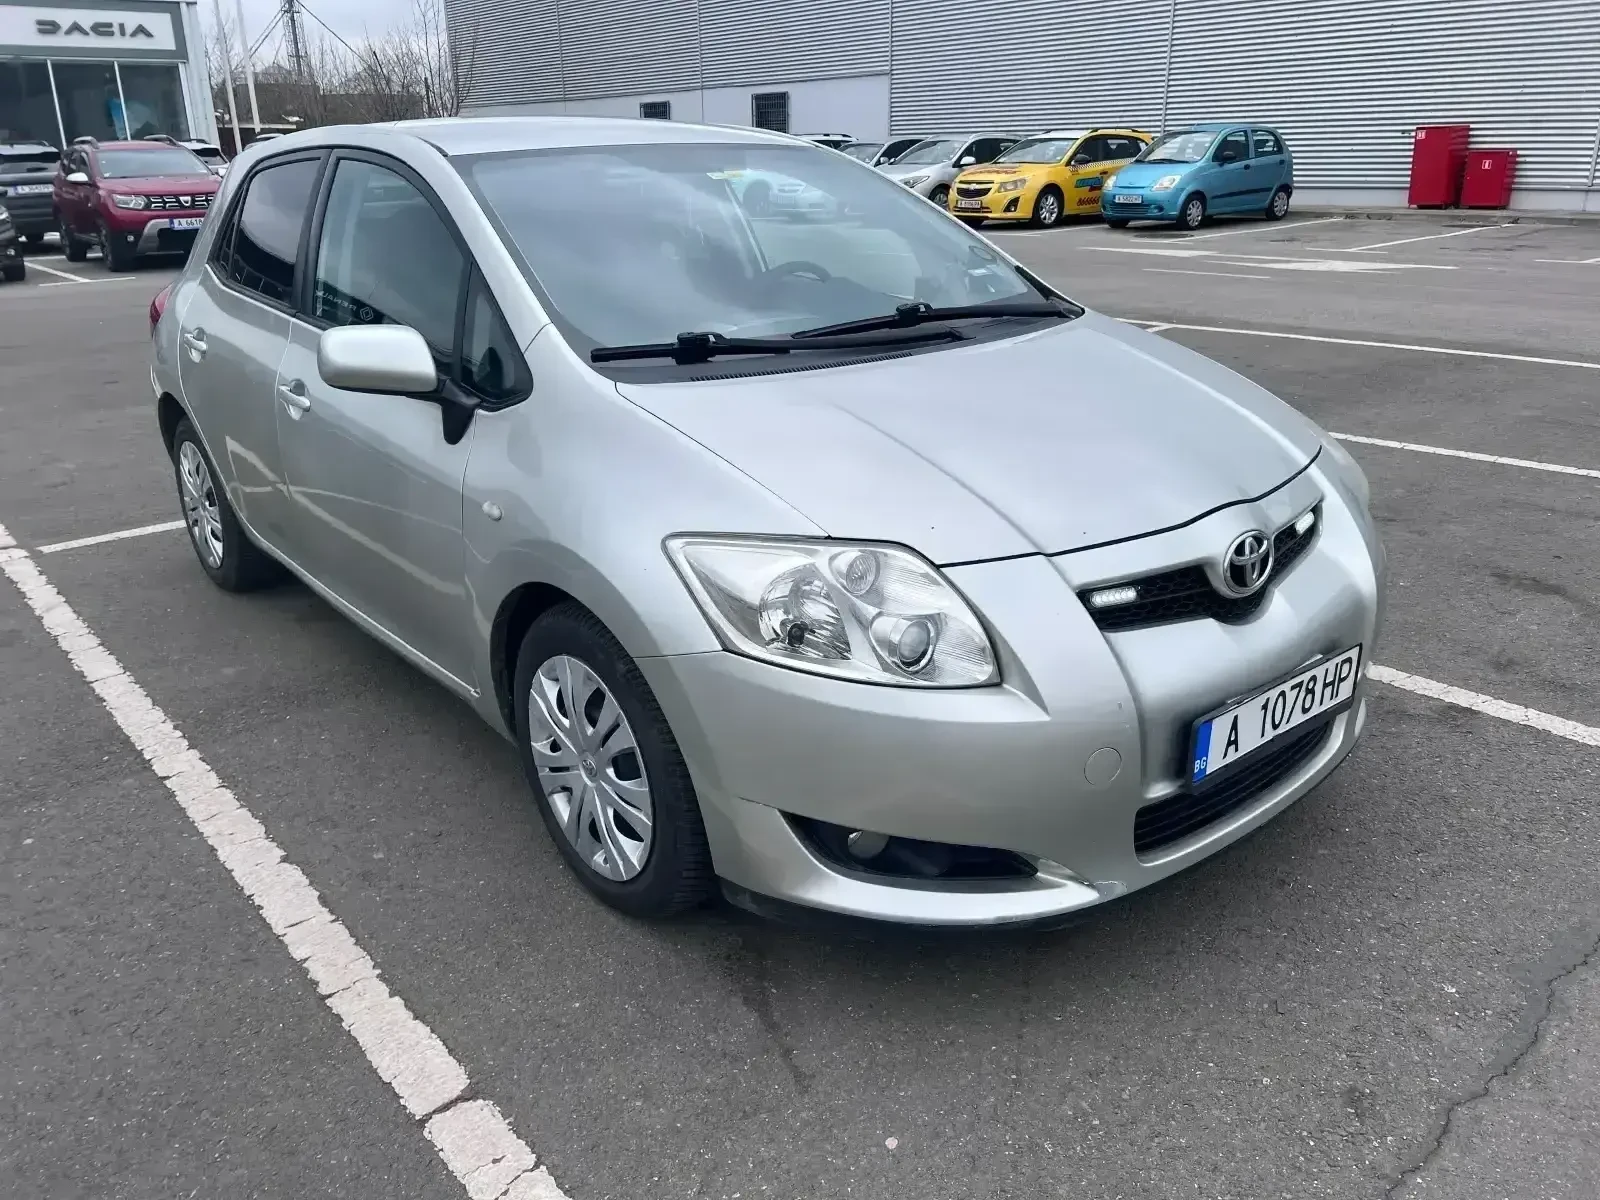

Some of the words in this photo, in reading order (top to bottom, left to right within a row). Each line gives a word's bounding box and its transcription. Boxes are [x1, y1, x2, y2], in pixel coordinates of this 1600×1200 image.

[35, 19, 154, 38] DACIA
[1222, 714, 1239, 760] A
[1194, 757, 1206, 773] BG
